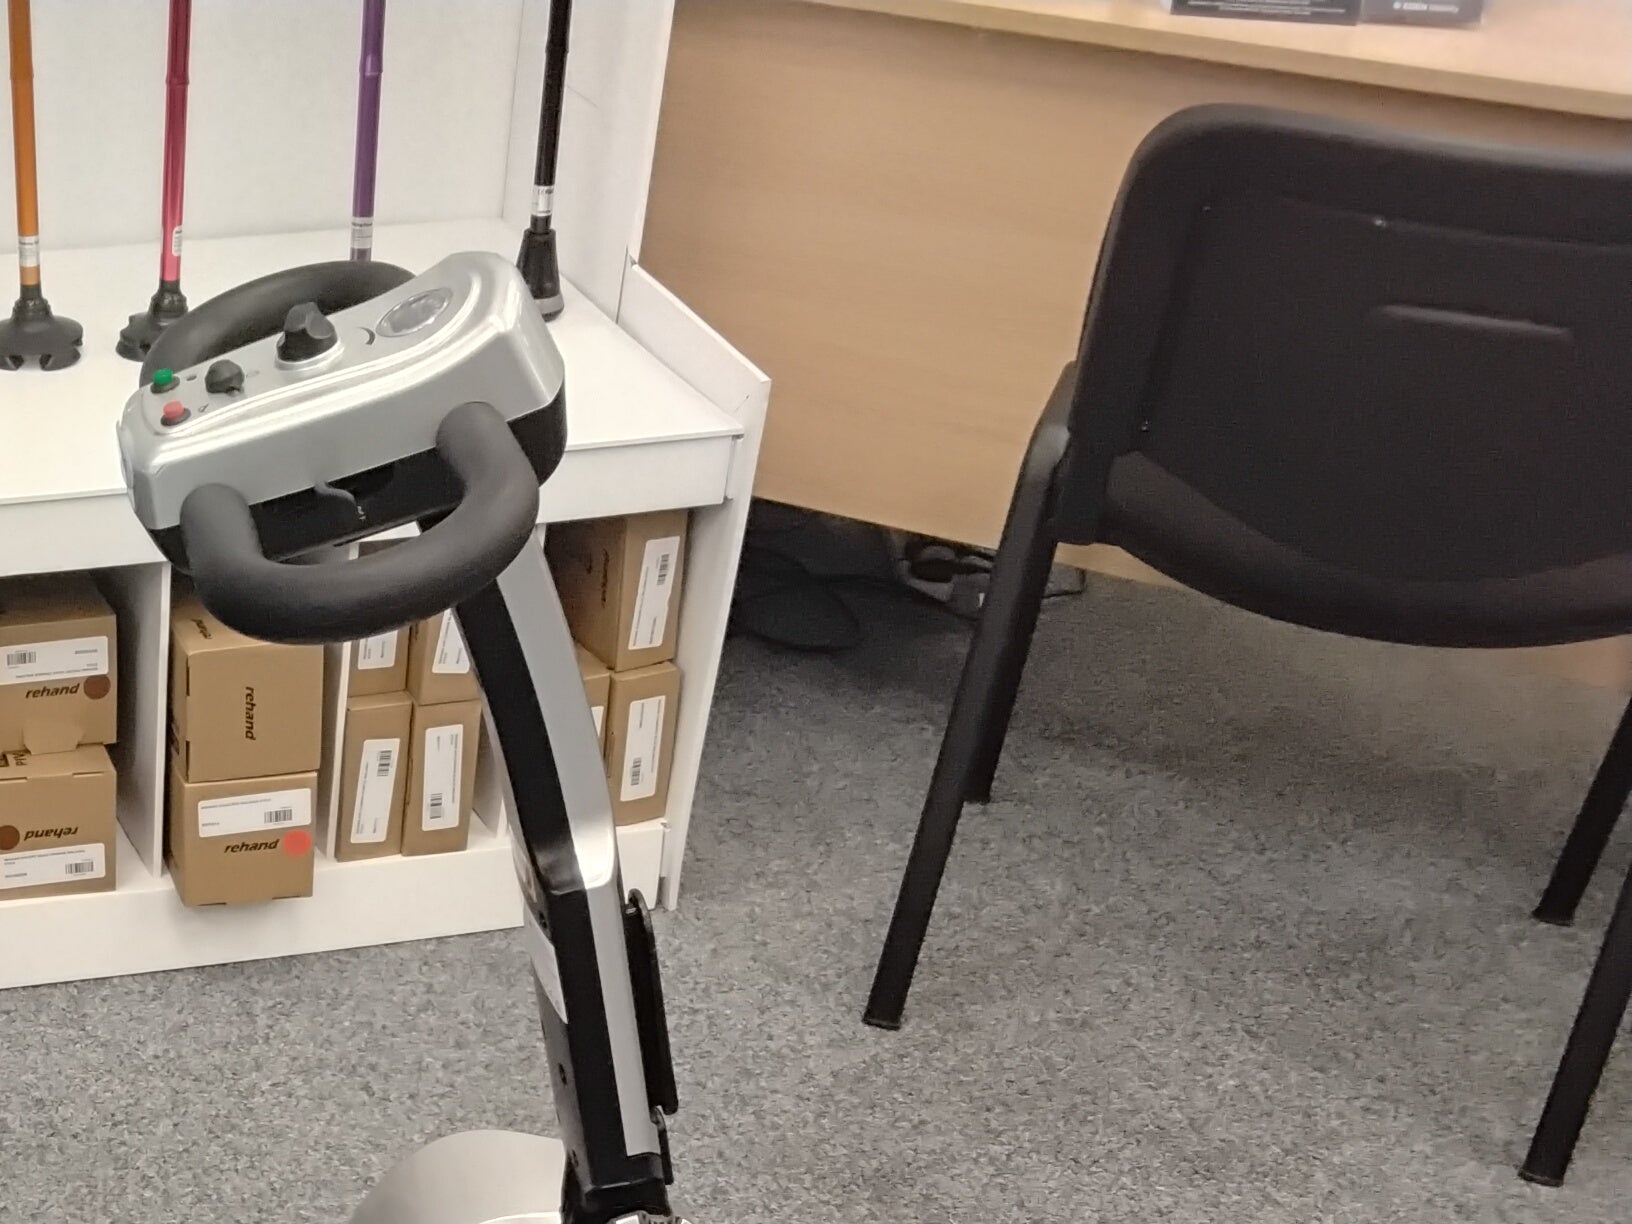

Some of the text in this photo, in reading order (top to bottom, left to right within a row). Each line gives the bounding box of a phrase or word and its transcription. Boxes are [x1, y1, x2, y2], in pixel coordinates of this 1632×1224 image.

[25, 682, 80, 699] rehand
[244, 686, 257, 741] rehand
[23, 826, 79, 841] rehand
[223, 838, 280, 854] rehand
